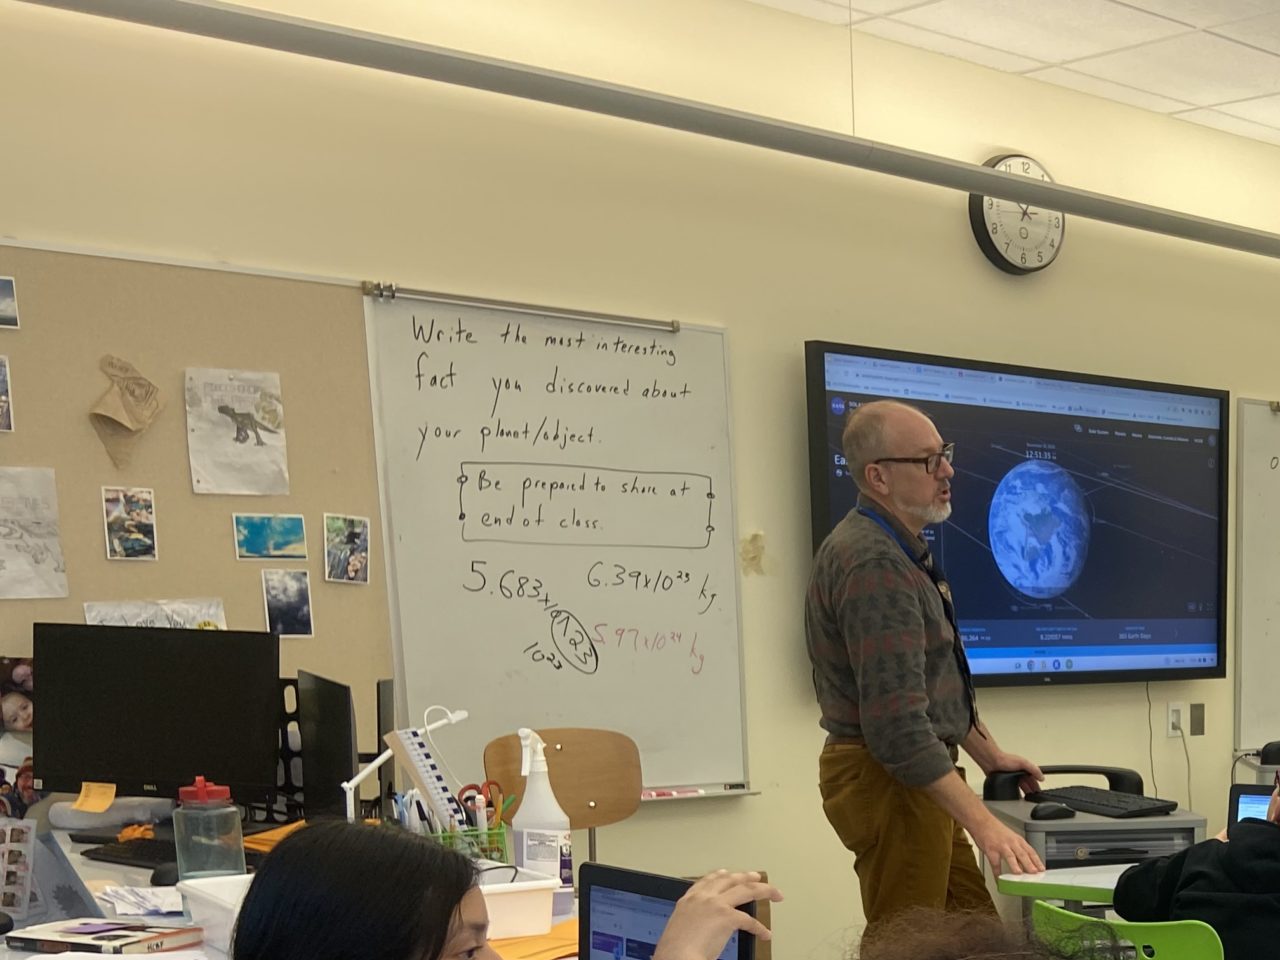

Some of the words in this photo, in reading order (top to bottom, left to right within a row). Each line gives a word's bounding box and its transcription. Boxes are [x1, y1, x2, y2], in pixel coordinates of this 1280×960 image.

[1022, 161, 1031, 174] 12
[991, 222, 998, 235] 8
[1054, 217, 1060, 229] 3
[1004, 242, 1010, 254] 7
[1049, 238, 1055, 249] 4
[1020, 252, 1027, 265] 6
[1037, 251, 1043, 263] 5
[412, 315, 478, 345] Write
[500, 321, 527, 345] the
[544, 331, 586, 348] most
[595, 334, 676, 366] interesting
[414, 351, 457, 391] fact
[491, 376, 522, 418] you
[545, 365, 630, 396] discovered
[641, 382, 692, 399] about
[415, 424, 462, 461] your
[477, 470, 503, 491] Be
[521, 472, 586, 508] prepared
[594, 477, 607, 493] to
[621, 475, 657, 496] share
[669, 480, 691, 496] at
[480, 504, 516, 526] end
[522, 504, 545, 528] of
